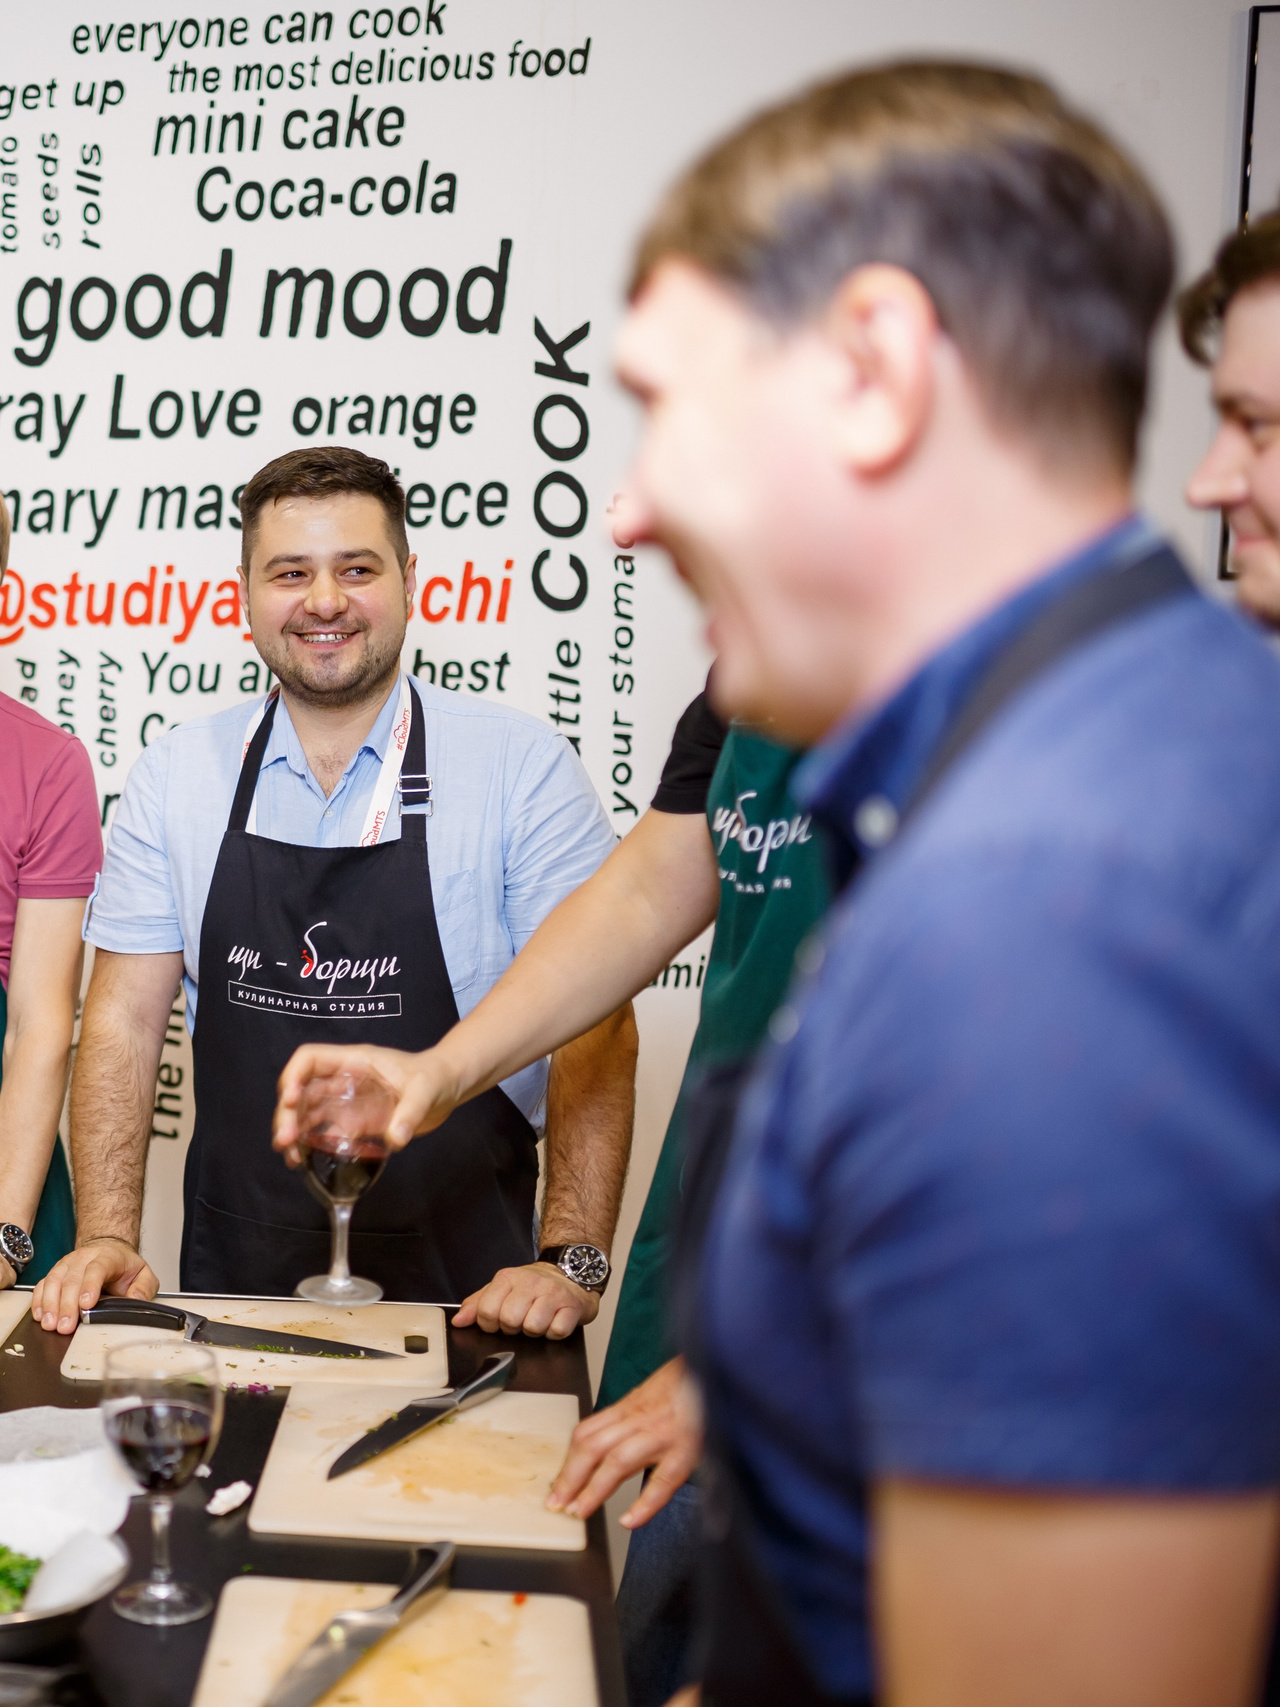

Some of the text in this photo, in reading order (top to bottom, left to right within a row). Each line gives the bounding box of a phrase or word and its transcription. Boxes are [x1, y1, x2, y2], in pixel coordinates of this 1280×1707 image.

[72, 0, 447, 61] everyone can cook
[74, 79, 125, 116] up
[168, 37, 592, 95] the most delicious food
[153, 94, 406, 157] mini cake
[36, 132, 61, 250] seeds
[75, 143, 102, 250] rolls
[196, 159, 458, 222] Coca-cola
[14, 248, 234, 368] good
[258, 237, 513, 340] mood
[108, 373, 263, 440] Love
[291, 393, 477, 450] orange
[530, 315, 592, 758] ttle COOK
[56, 648, 81, 736] oney
[141, 651, 221, 695] You
[412, 648, 511, 693] best
[96, 650, 124, 768] cherry
[611, 710, 639, 818] your
[370, 810, 386, 846] oudMTS
[237, 989, 387, 1013] КУЛИНАРНАЯ СТУДИЯ
